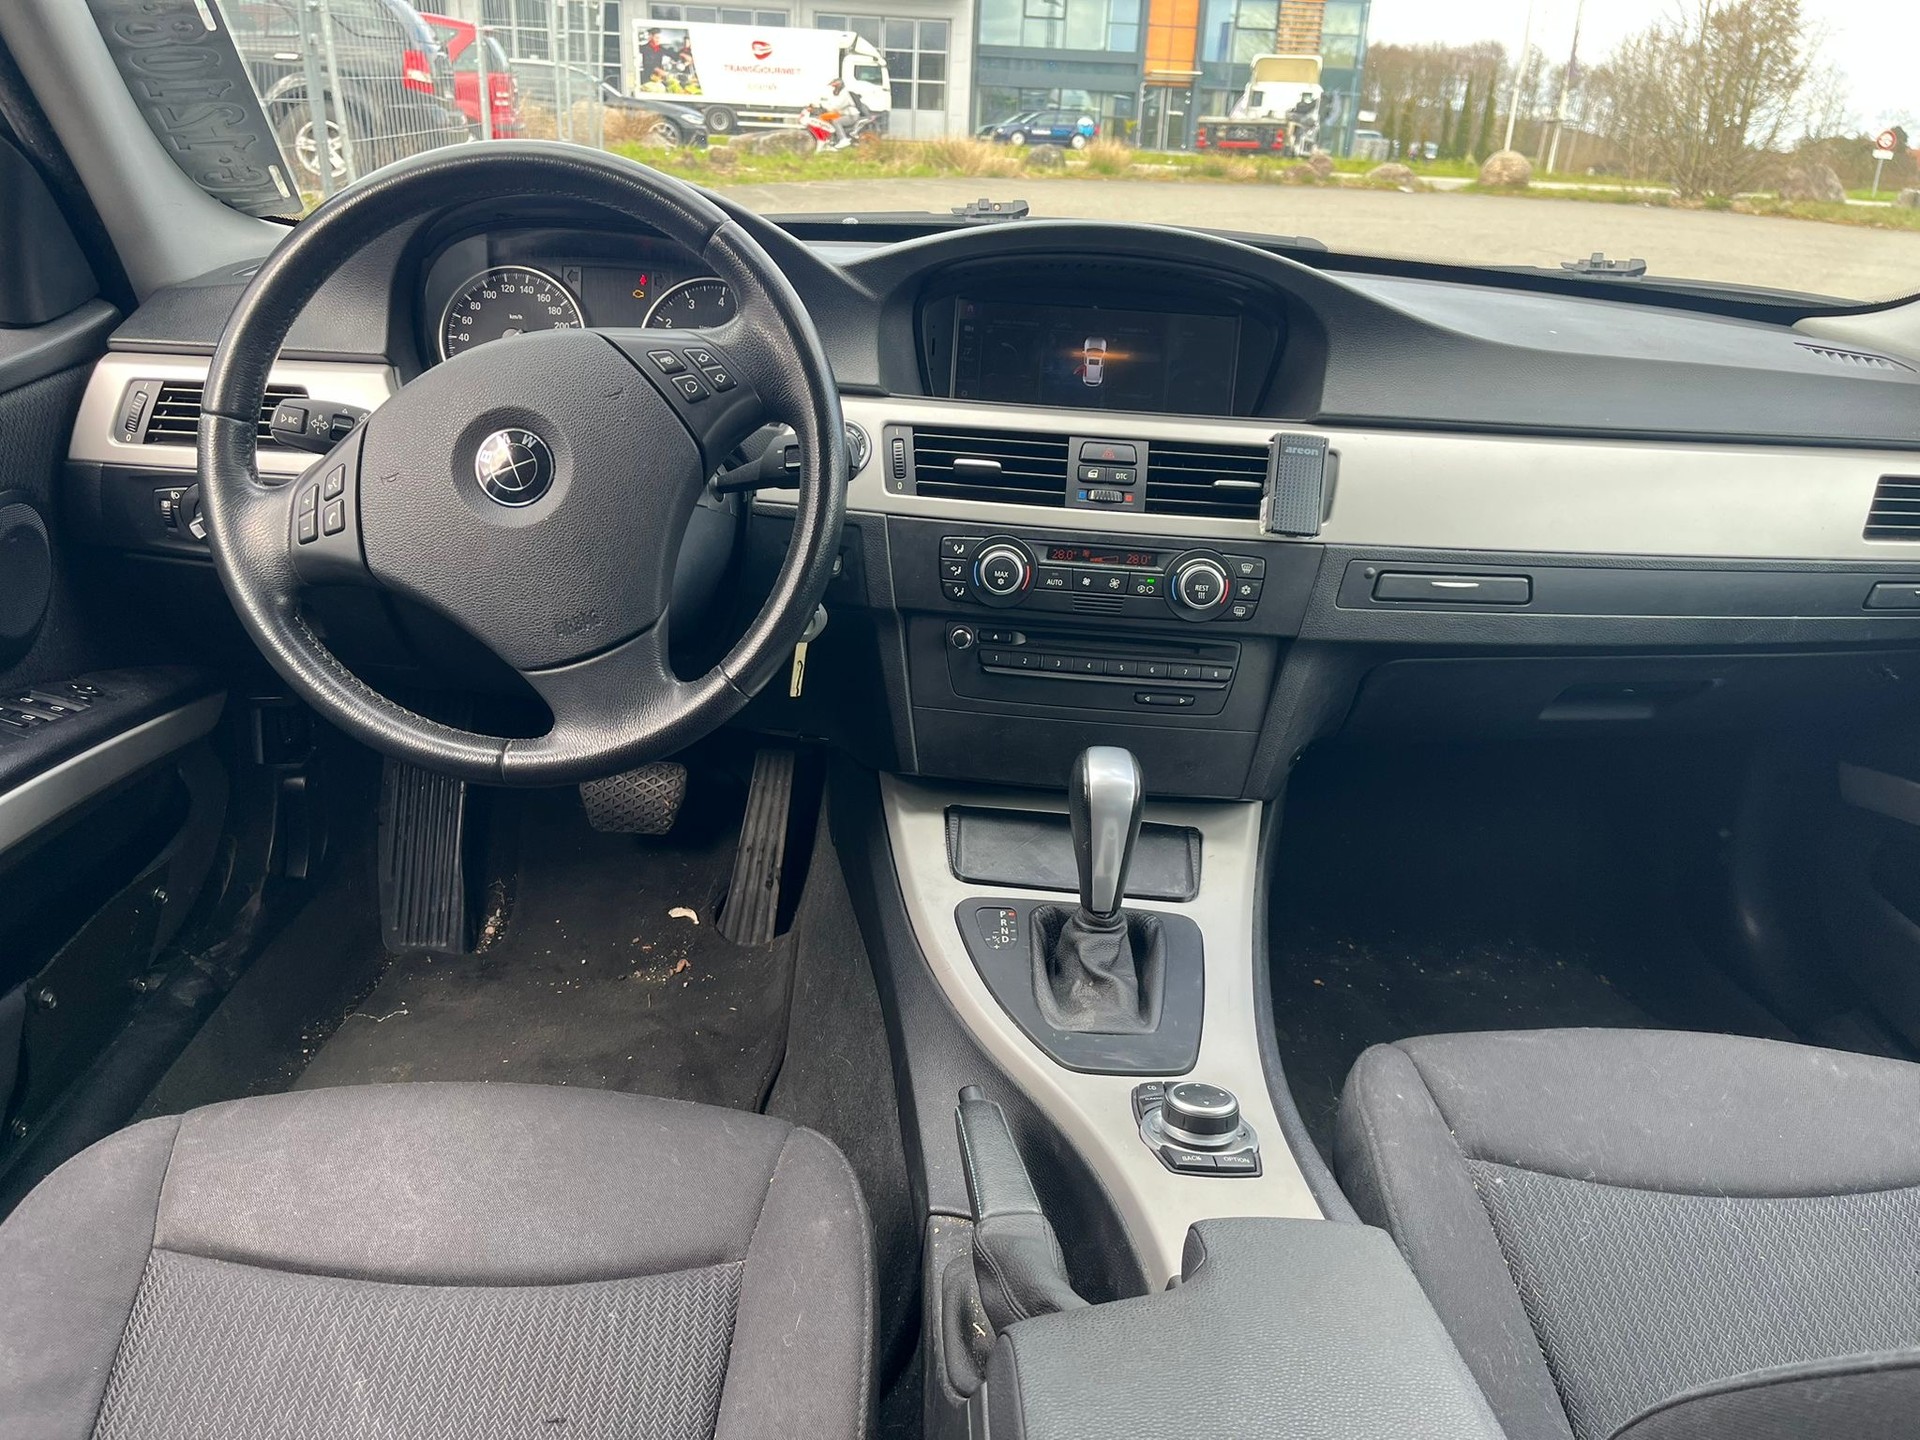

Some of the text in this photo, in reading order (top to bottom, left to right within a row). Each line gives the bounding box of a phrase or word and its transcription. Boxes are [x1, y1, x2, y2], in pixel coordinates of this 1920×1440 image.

[500, 284, 515, 294] 120
[520, 285, 534, 294] 140
[482, 290, 497, 300] 100
[536, 293, 551, 303] 160
[470, 301, 481, 311] 80
[688, 299, 695, 310] 3
[718, 297, 725, 308] 4
[548, 306, 562, 316] 180
[462, 315, 472, 326] 60
[666, 318, 672, 328] 2
[458, 332, 470, 342] 40
[288, 416, 298, 424] BC
[1284, 446, 1319, 456] areon
[1115, 472, 1128, 480] DTC
[994, 570, 1008, 578] MAX
[1194, 584, 1210, 592] REST
[1000, 918, 1008, 926] R
